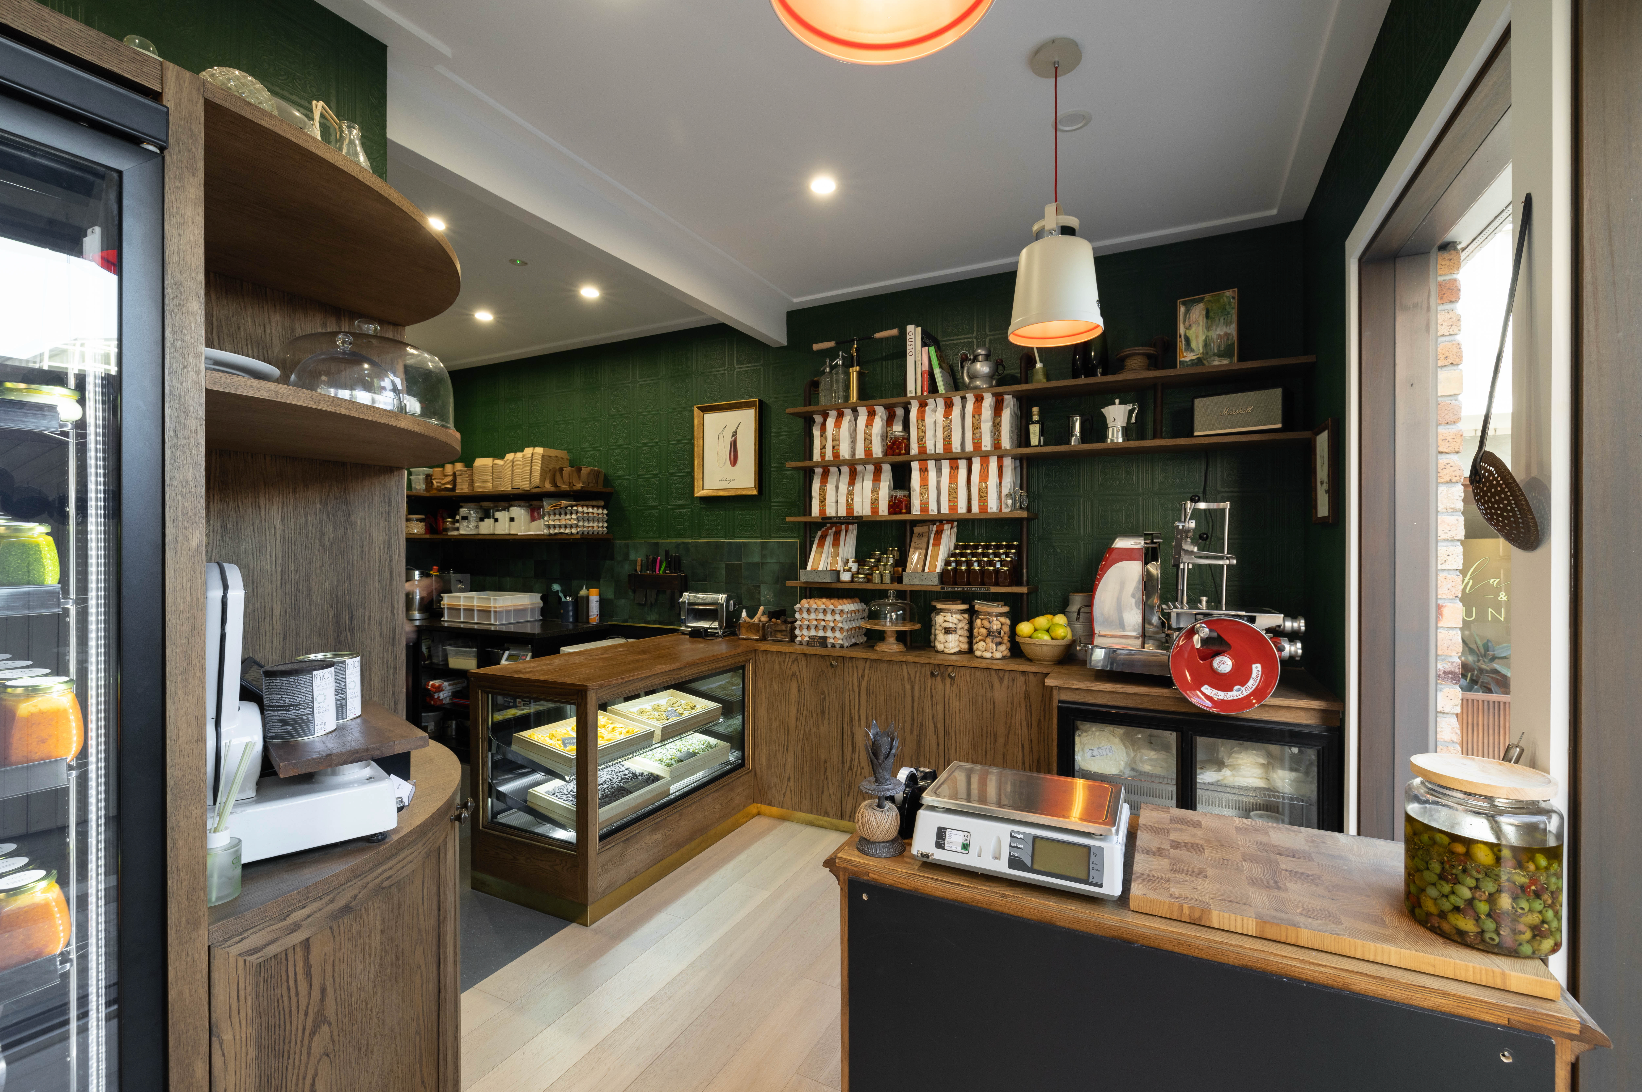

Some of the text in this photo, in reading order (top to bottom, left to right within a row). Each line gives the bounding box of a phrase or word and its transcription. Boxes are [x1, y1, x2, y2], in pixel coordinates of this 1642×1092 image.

[944, 400, 954, 410] M
[919, 467, 929, 477] M
[949, 465, 959, 475] M
[980, 463, 989, 474] M
